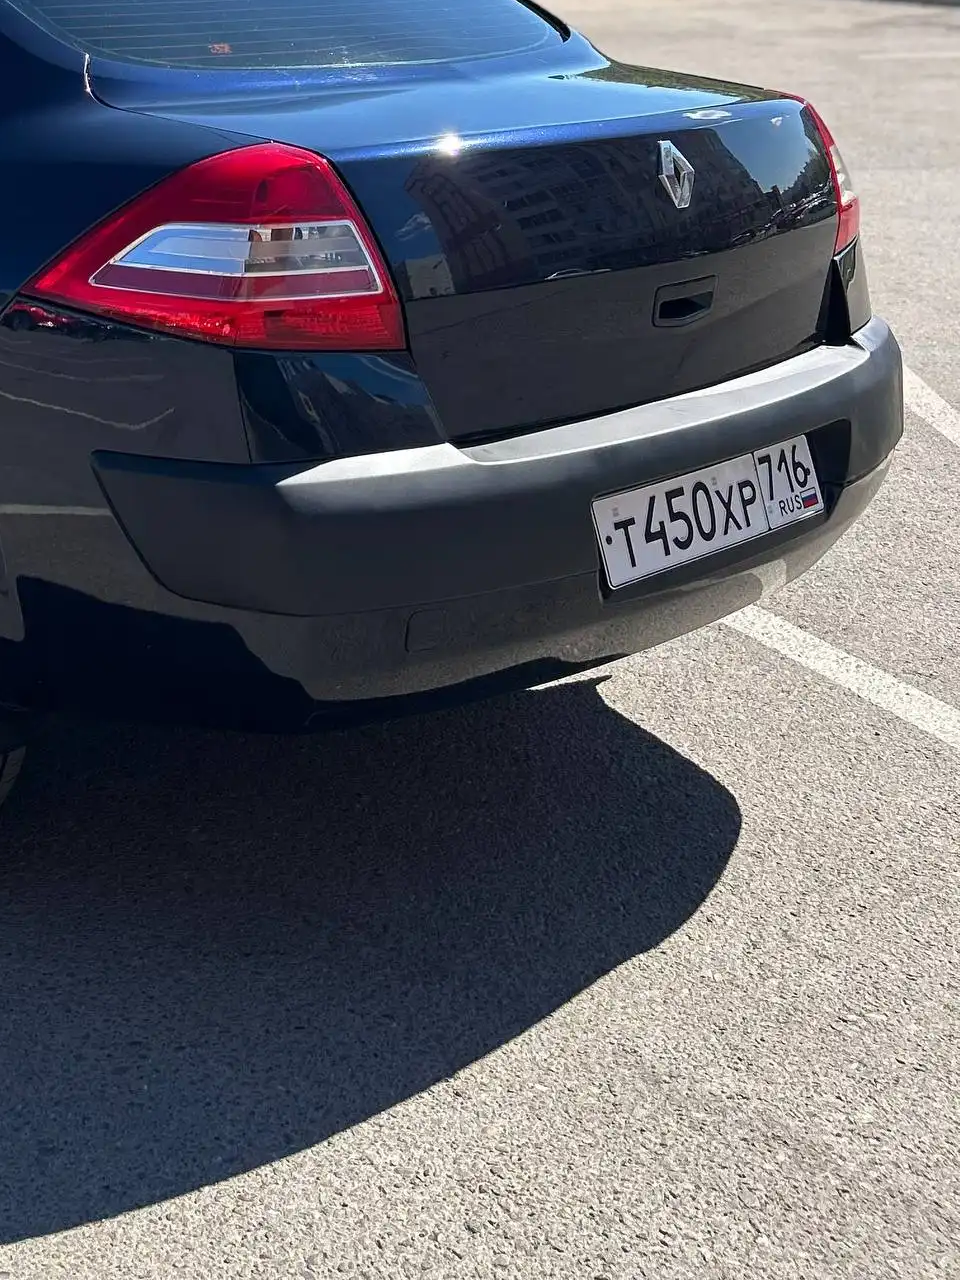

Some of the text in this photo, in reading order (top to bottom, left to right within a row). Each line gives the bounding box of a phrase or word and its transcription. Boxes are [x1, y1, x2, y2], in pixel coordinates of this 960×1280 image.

[613, 444, 809, 568] Т450ХР 716
[778, 498, 803, 517] RUS
